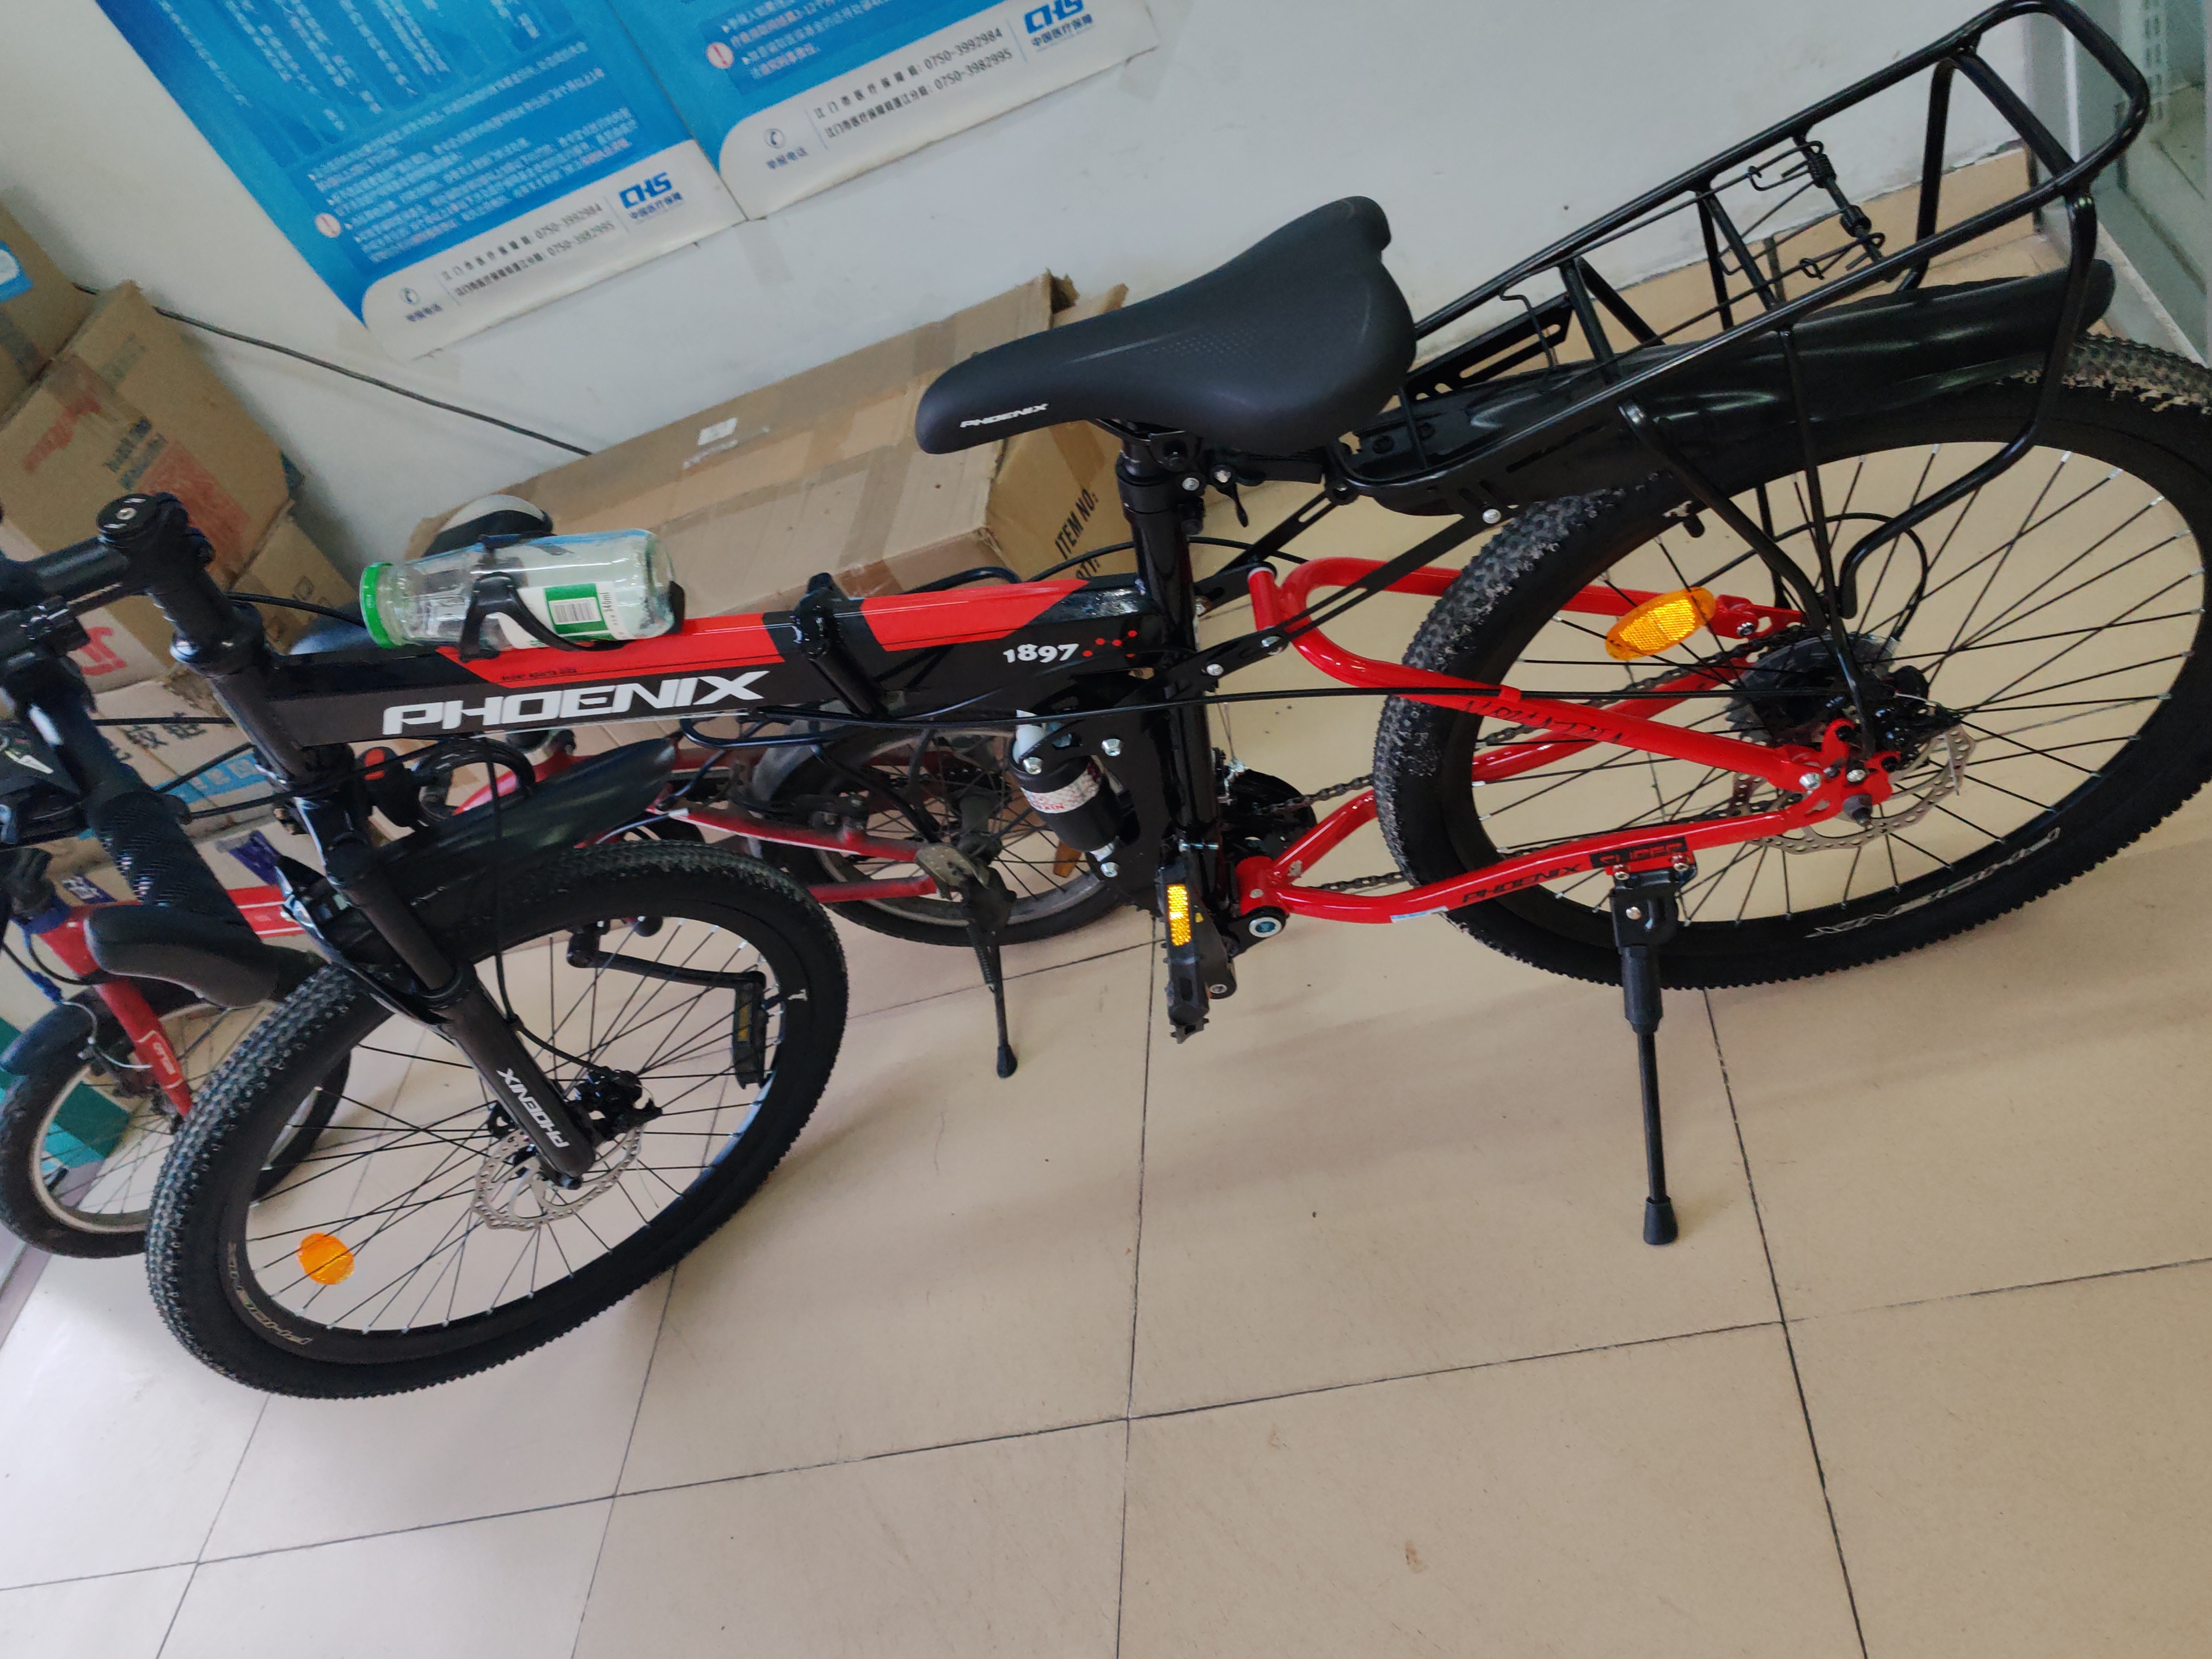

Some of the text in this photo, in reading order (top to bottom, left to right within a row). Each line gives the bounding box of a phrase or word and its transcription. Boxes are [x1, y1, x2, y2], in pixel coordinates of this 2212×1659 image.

[618, 171, 674, 210] CHS
[960, 403, 1049, 428] PHOENIX
[1054, 511, 1084, 561] ITEM
[1003, 643, 1079, 664] 1897
[383, 671, 770, 736] PHOENIX
[496, 1068, 570, 1147] PHOENIX
